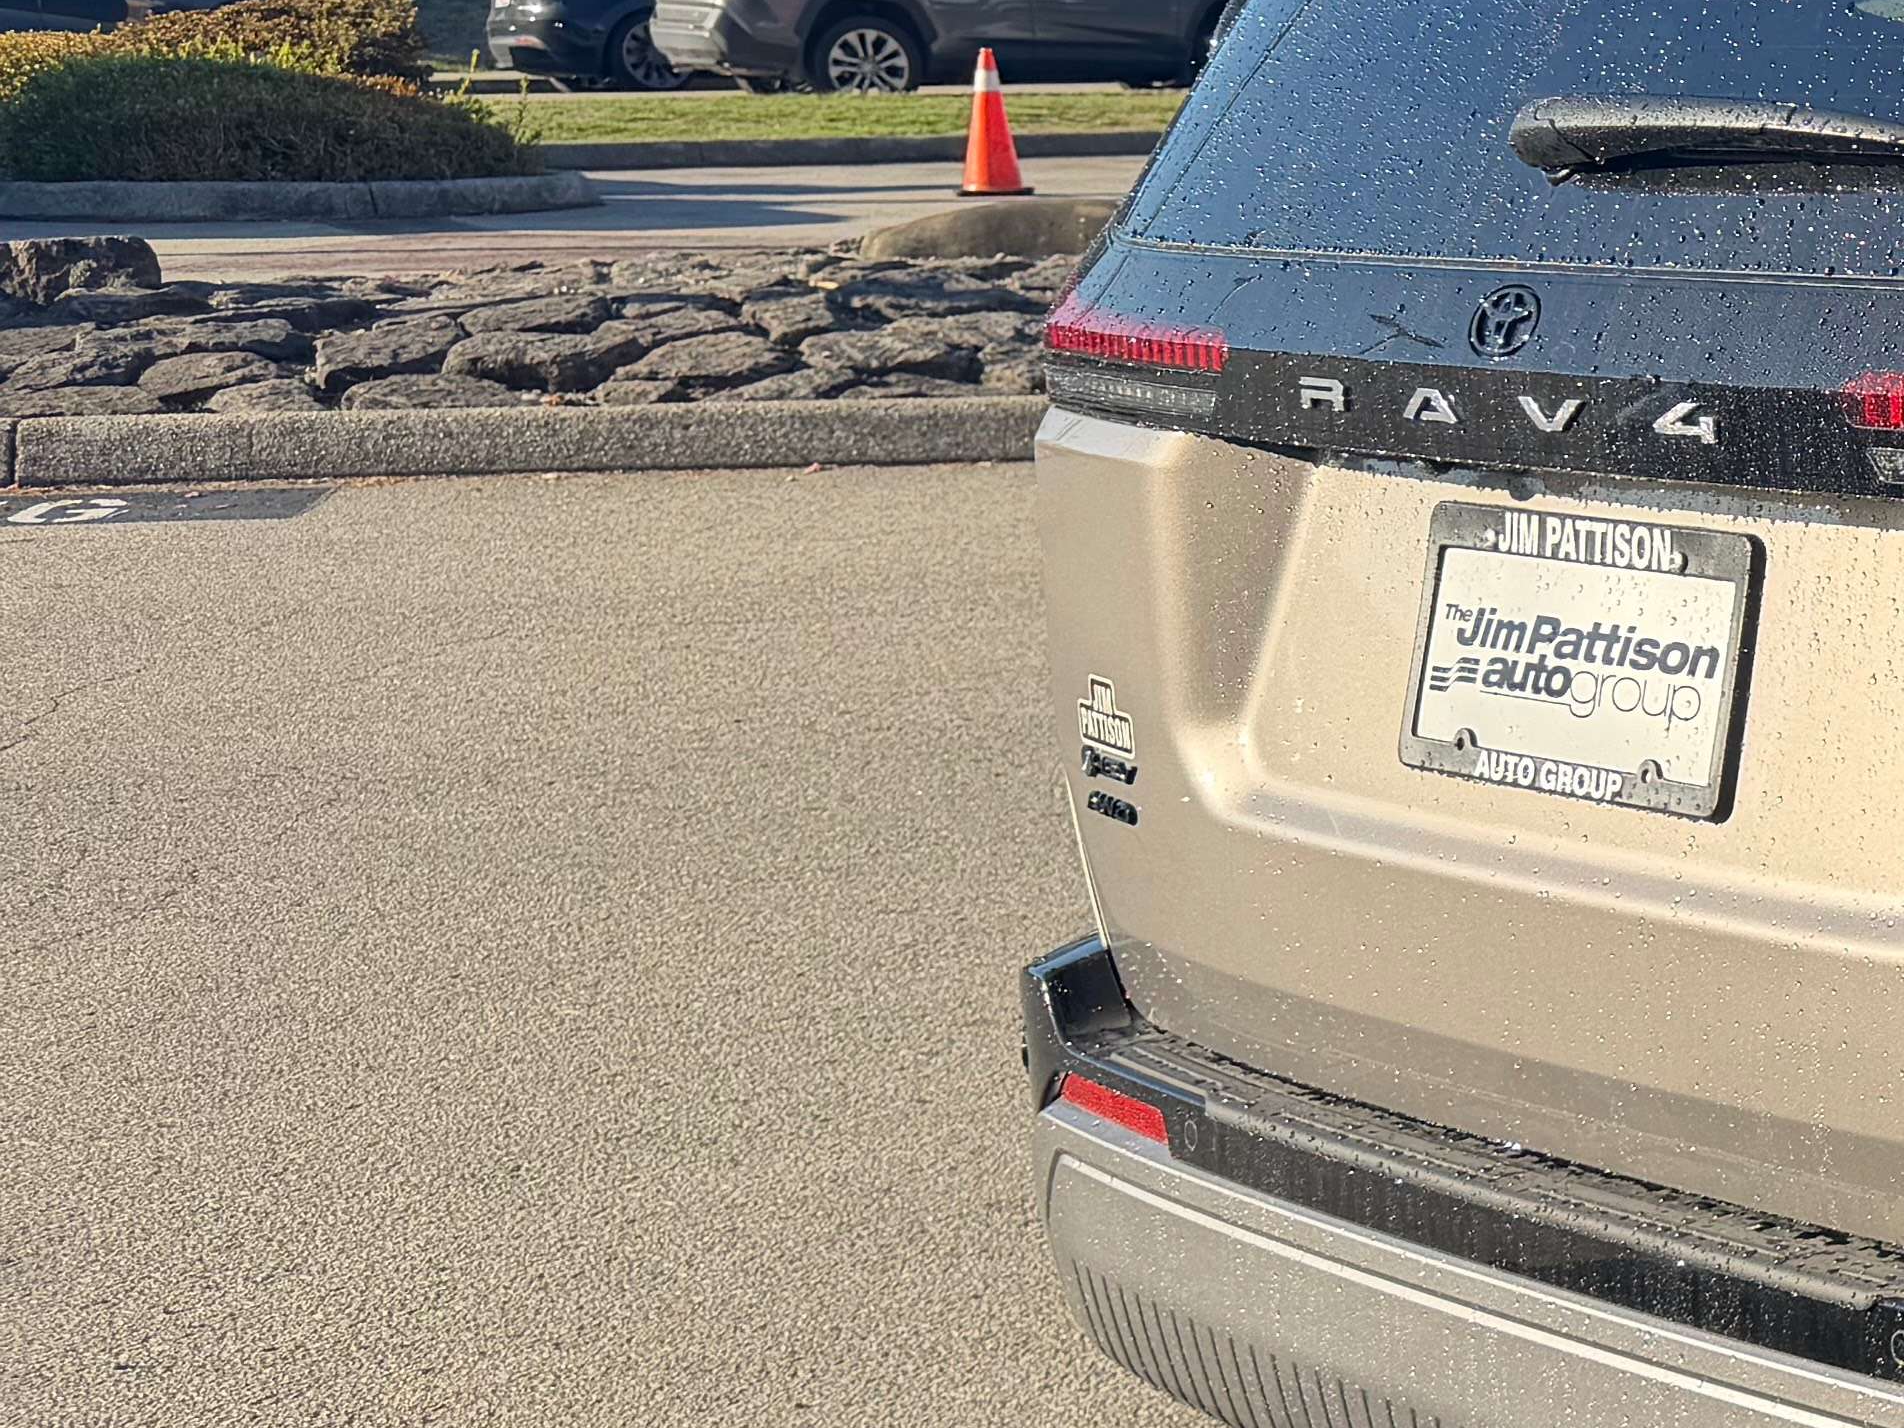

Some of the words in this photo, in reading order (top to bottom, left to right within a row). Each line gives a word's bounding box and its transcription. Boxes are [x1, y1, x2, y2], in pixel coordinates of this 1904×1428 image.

[1298, 375, 1718, 445] RAV4
[1499, 511, 1539, 556] JIM
[1545, 518, 1675, 572] PATTISON
[1445, 603, 1473, 623] The
[1092, 683, 1113, 716] JIM
[1080, 706, 1132, 750] PATTISON
[1476, 750, 1535, 784] AUTO
[1539, 760, 1624, 801] GROUP
